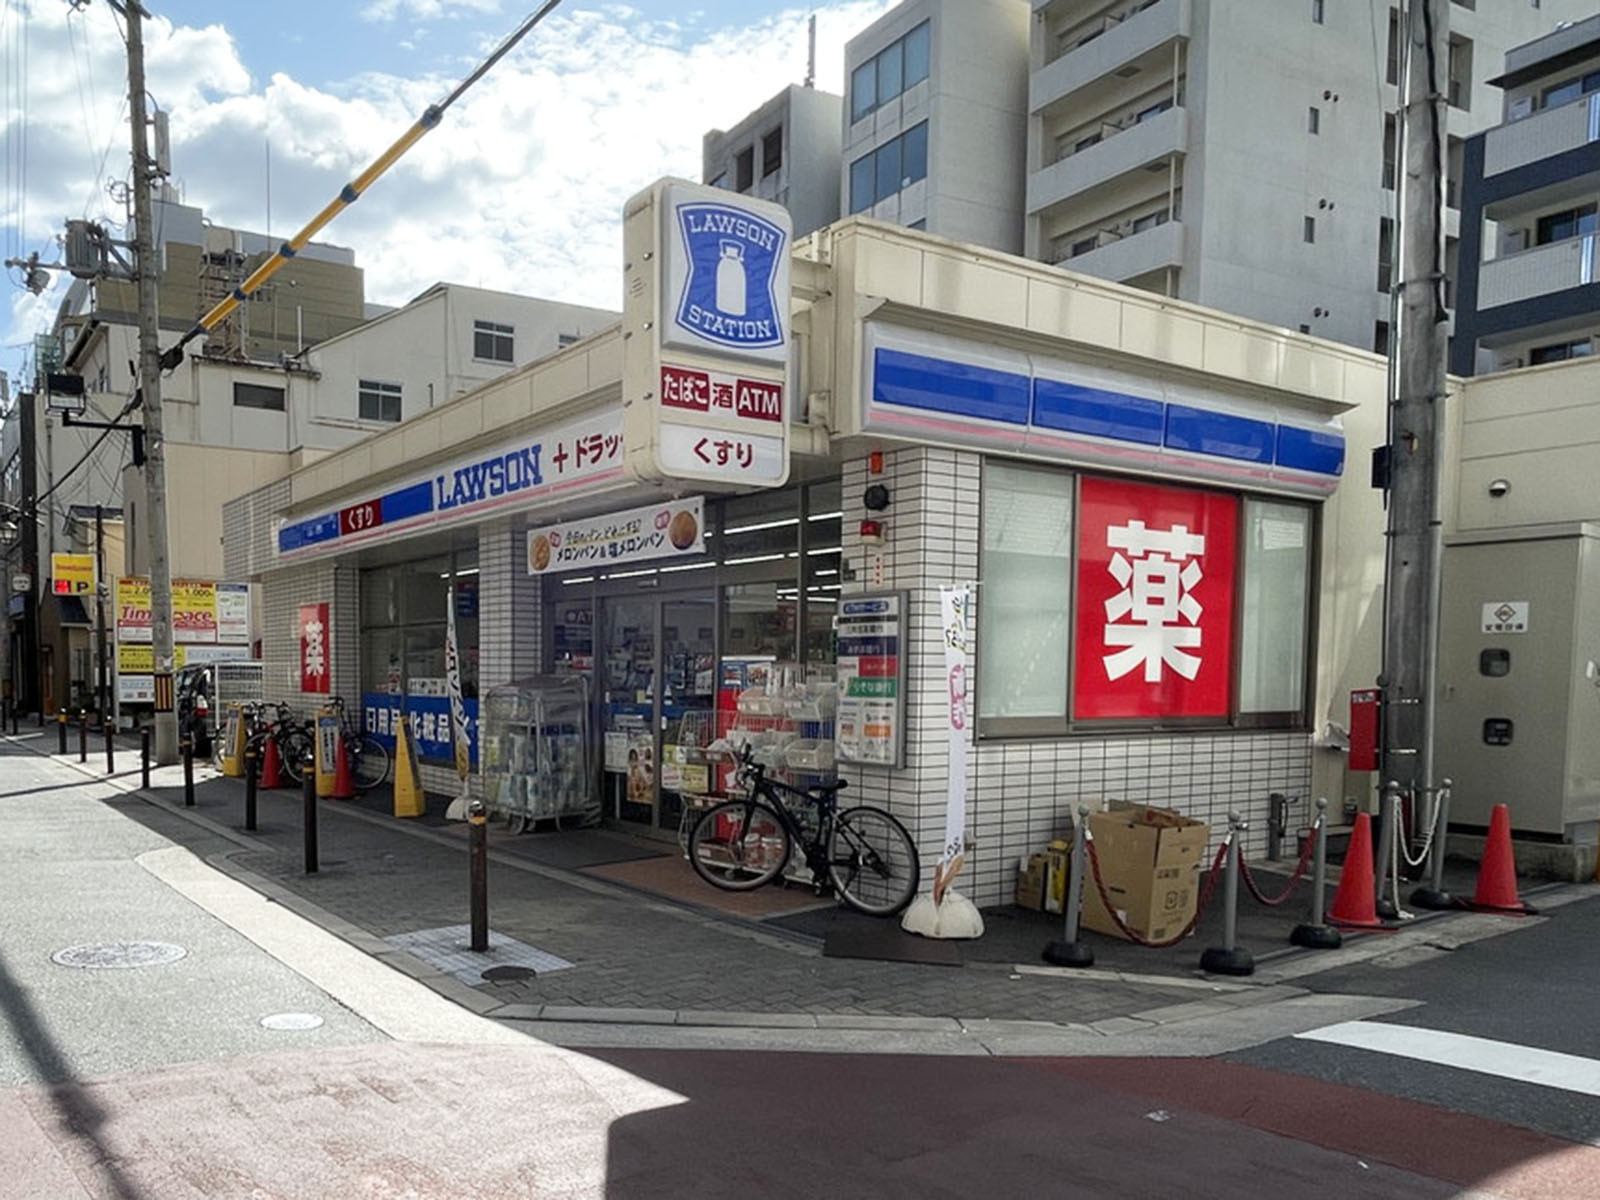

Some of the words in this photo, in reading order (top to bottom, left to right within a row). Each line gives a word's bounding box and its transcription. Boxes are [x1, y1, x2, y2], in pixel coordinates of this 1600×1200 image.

[688, 214, 775, 252] LAWSON
[688, 304, 773, 340] STATION
[663, 373, 708, 407] たばこ
[712, 382, 734, 410] 酒
[738, 387, 780, 416] ATM
[693, 437, 754, 469] くすり
[438, 444, 543, 511] LAWSON
[348, 504, 374, 530] くすり
[1102, 519, 1206, 683] 薬
[305, 620, 325, 677] 薬
